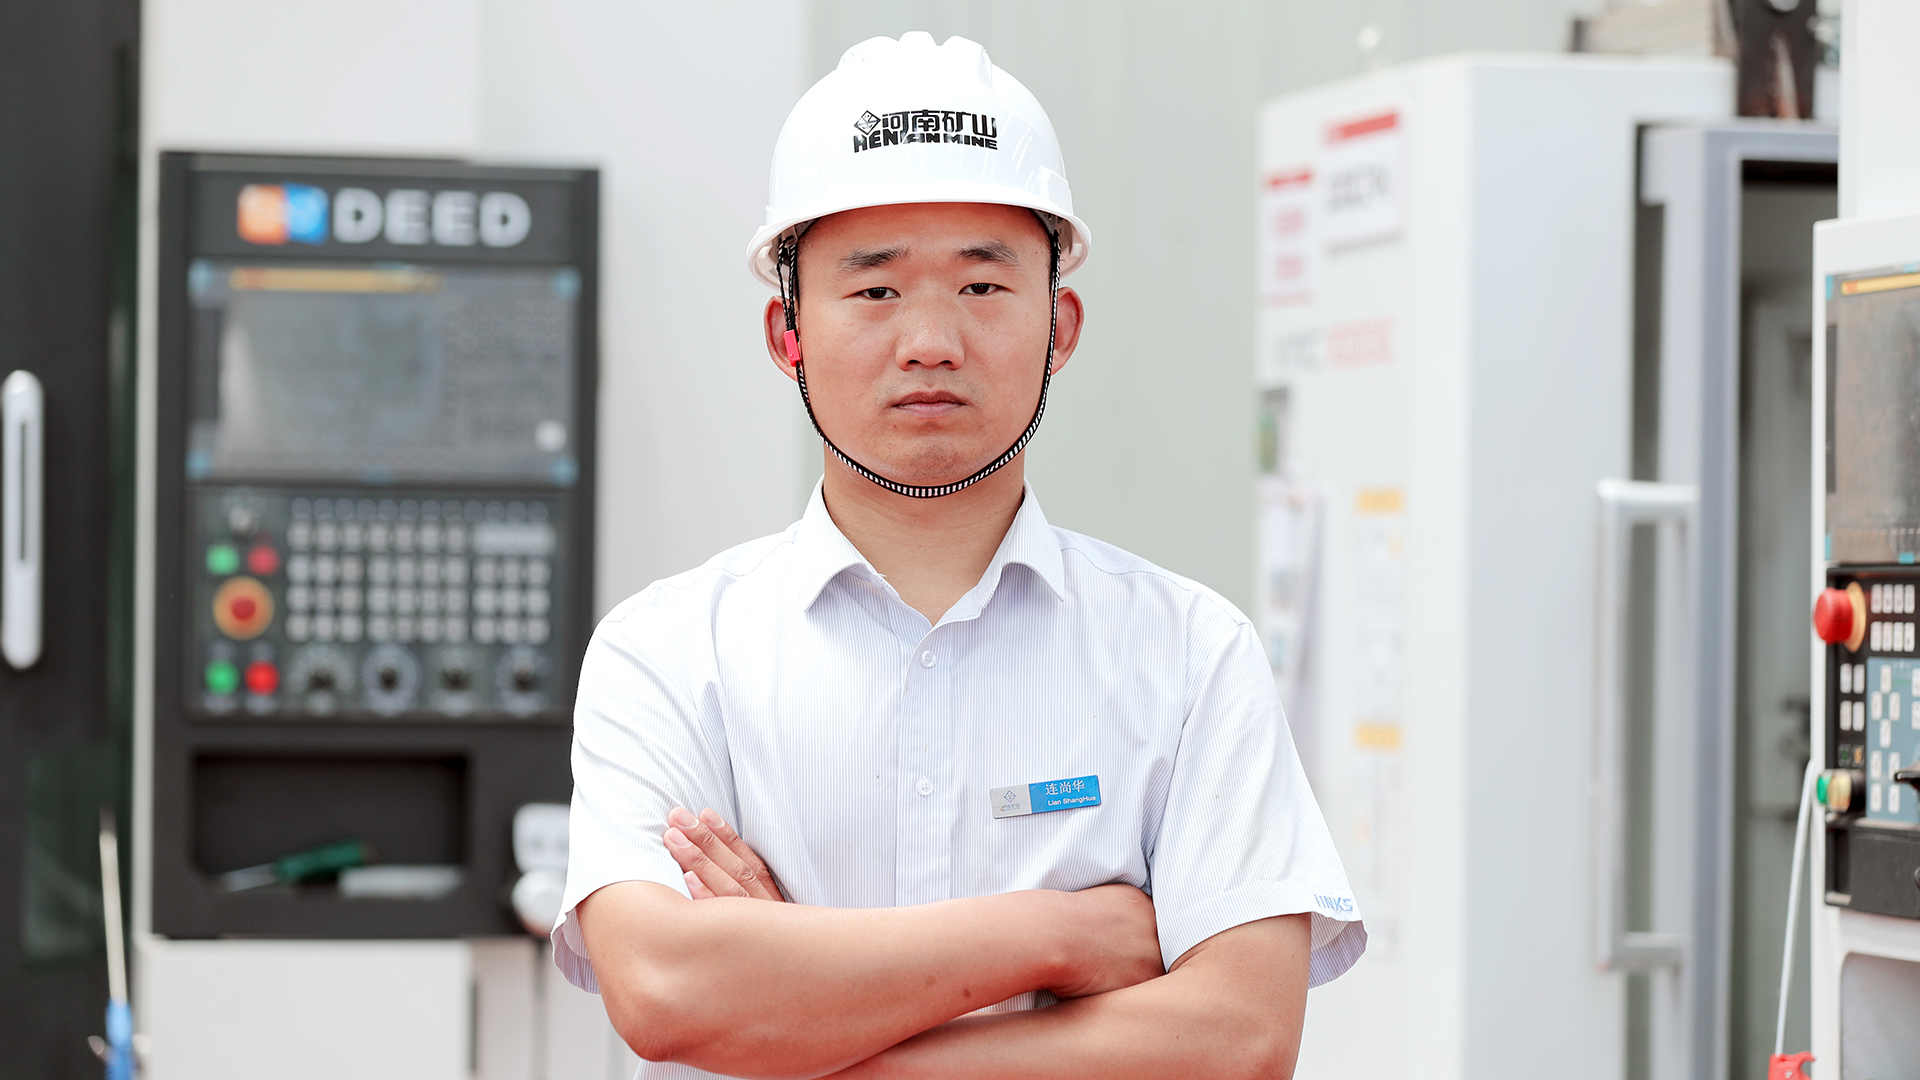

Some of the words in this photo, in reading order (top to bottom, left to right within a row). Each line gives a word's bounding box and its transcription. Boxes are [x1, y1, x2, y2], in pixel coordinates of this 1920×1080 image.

[881, 109, 998, 139] 河南矿山
[853, 129, 940, 153] HENAN
[943, 133, 998, 151] MINE
[332, 186, 532, 248] DEED
[1045, 779, 1086, 796] 连尚华
[1047, 799, 1062, 807] Lian
[1062, 795, 1097, 805] ShangHua
